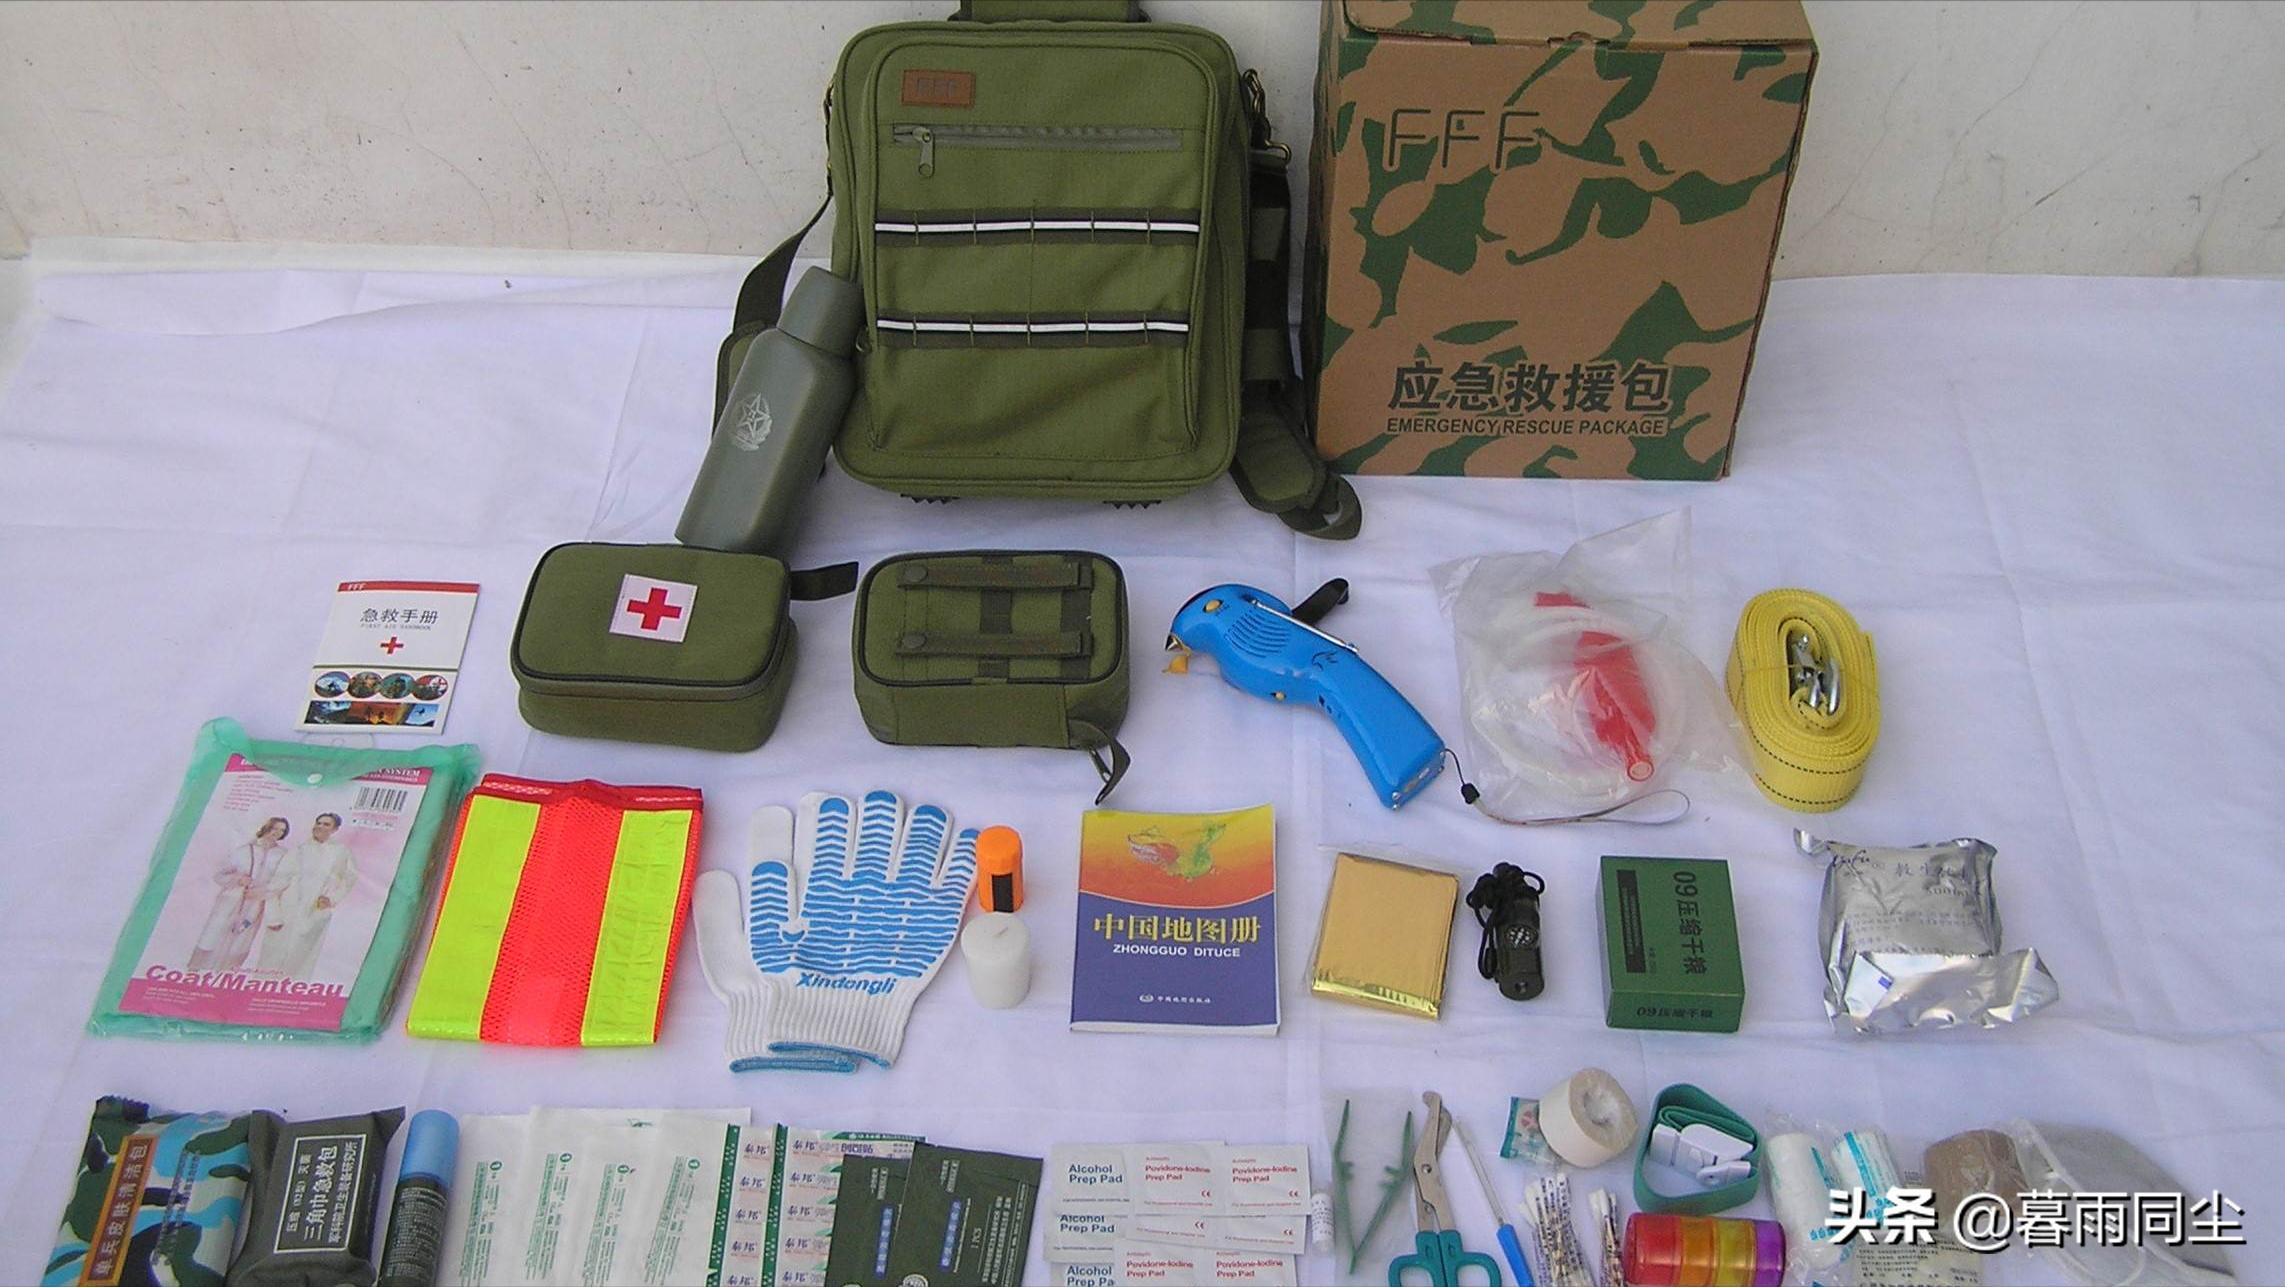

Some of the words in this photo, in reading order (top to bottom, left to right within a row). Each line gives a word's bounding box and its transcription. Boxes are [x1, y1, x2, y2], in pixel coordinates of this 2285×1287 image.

[1385, 108, 1541, 170] FFF
[1388, 360, 1671, 412] 应急救援包
[1387, 417, 1498, 435] EMERGENCY
[1502, 418, 1574, 435] RESCUE
[1579, 418, 1665, 435] PACKAGE
[359, 607, 439, 625] 急救手册
[1093, 912, 1262, 945] 中国地图册
[1672, 870, 1708, 975] 09压缩干粮
[1112, 943, 1188, 957] ZHONGGUO
[1193, 946, 1241, 958] DITUCE
[144, 964, 345, 998] Coat/Manteau
[795, 971, 898, 997] Xindongli
[1068, 1163, 1113, 1174] Alcohol
[1069, 1174, 1097, 1185] Prep
[1100, 1174, 1123, 1184] Pad
[1145, 1173, 1165, 1181] Prep
[304, 1145, 338, 1241] 三角巾急救包
[1060, 1223, 1088, 1234] Prep
[1091, 1224, 1115, 1234] Pad
[1067, 1265, 1113, 1276] Alcohol
[1126, 1270, 1145, 1278] Prep
[1148, 1269, 1166, 1277] Pad
[1216, 1269, 1236, 1278] Prep
[1237, 1269, 1255, 1277] Pad
[1067, 1276, 1095, 1287] Prep
[1098, 1276, 1115, 1287] Pa
